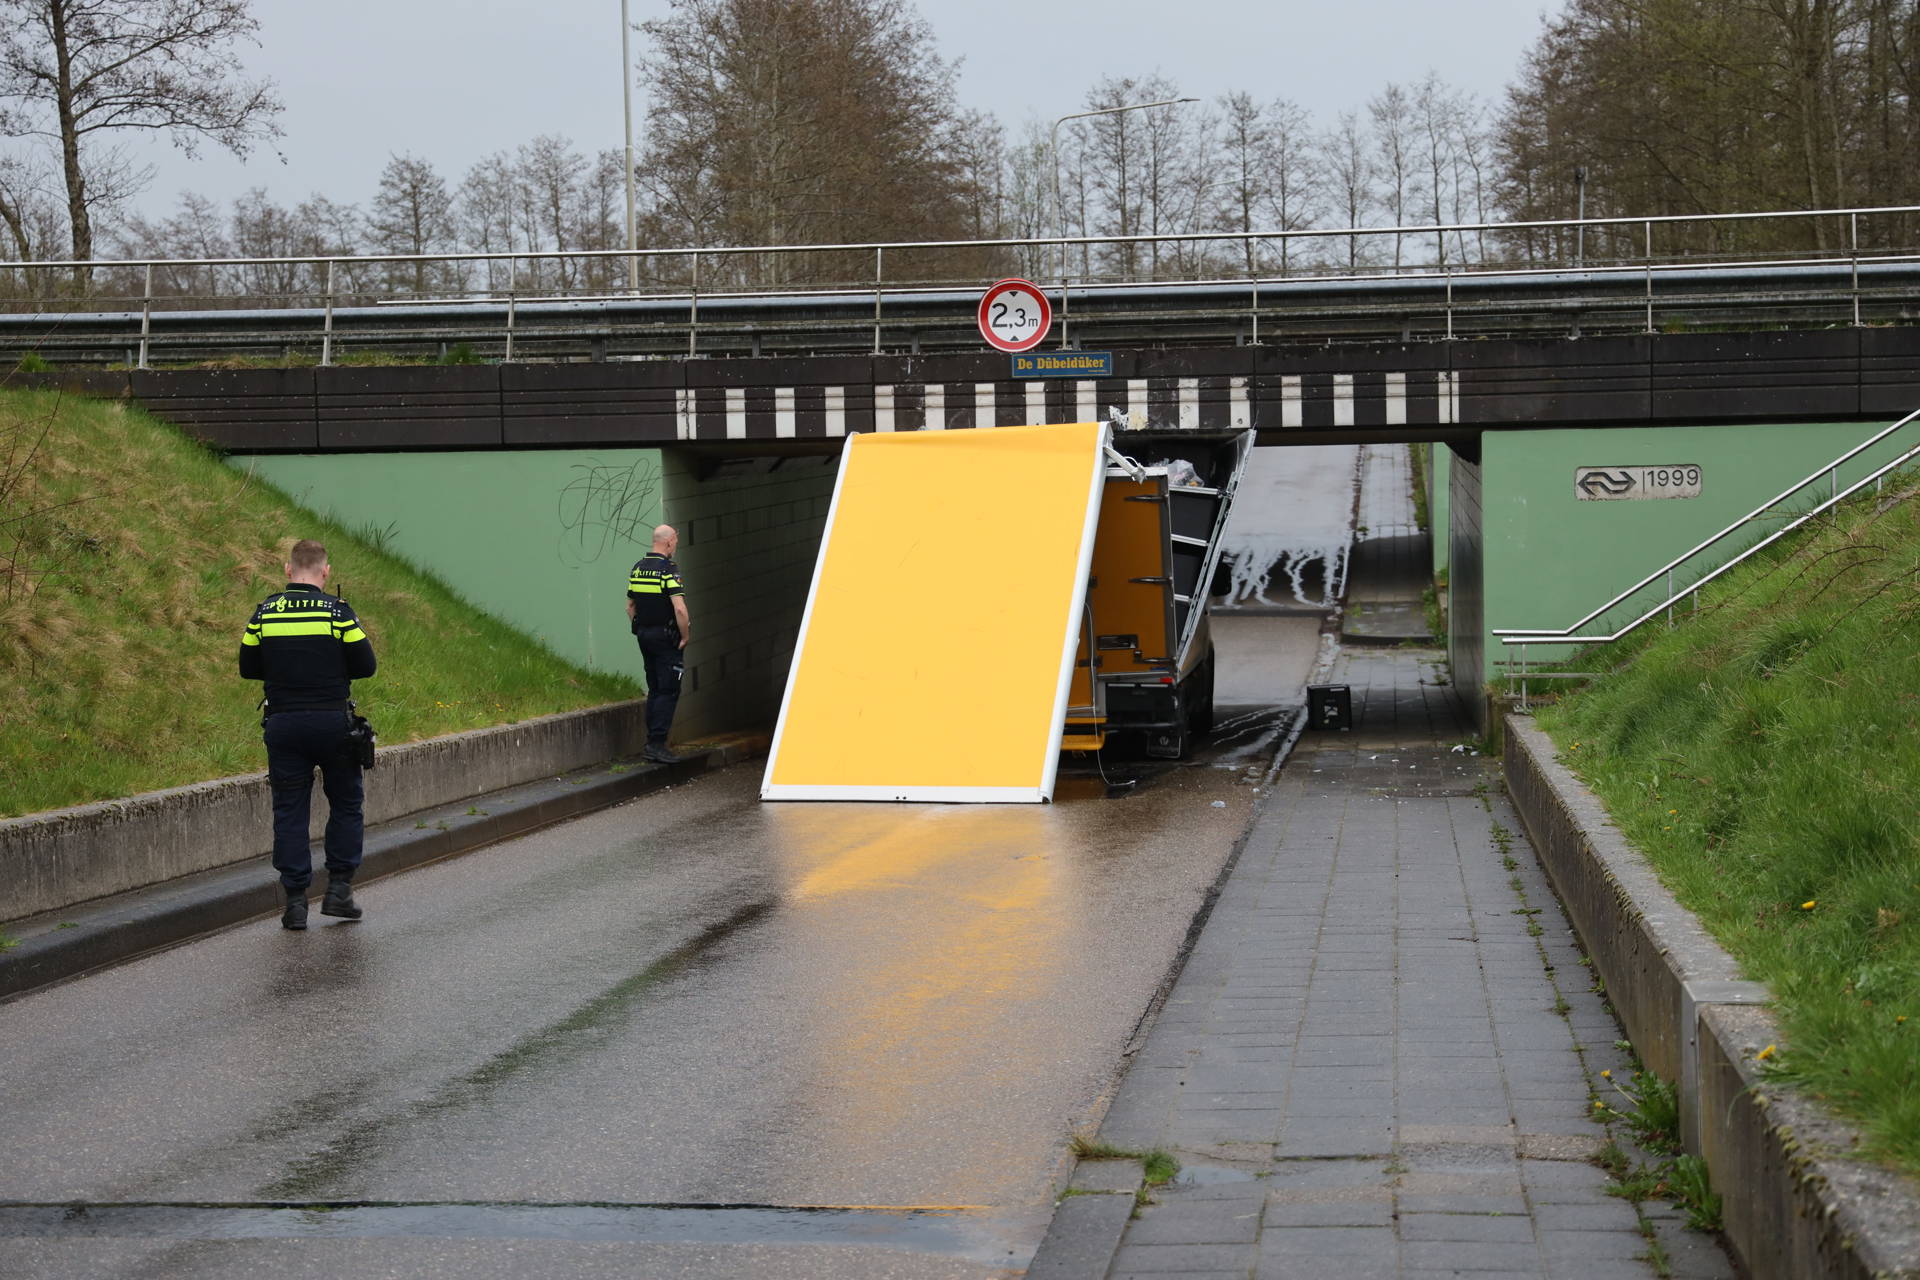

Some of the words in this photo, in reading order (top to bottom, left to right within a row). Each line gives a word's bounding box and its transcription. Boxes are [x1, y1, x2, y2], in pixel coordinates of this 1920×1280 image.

[1017, 358, 1033, 370] De
[1647, 469, 1699, 487] 1999
[269, 597, 324, 612] POLITIE
